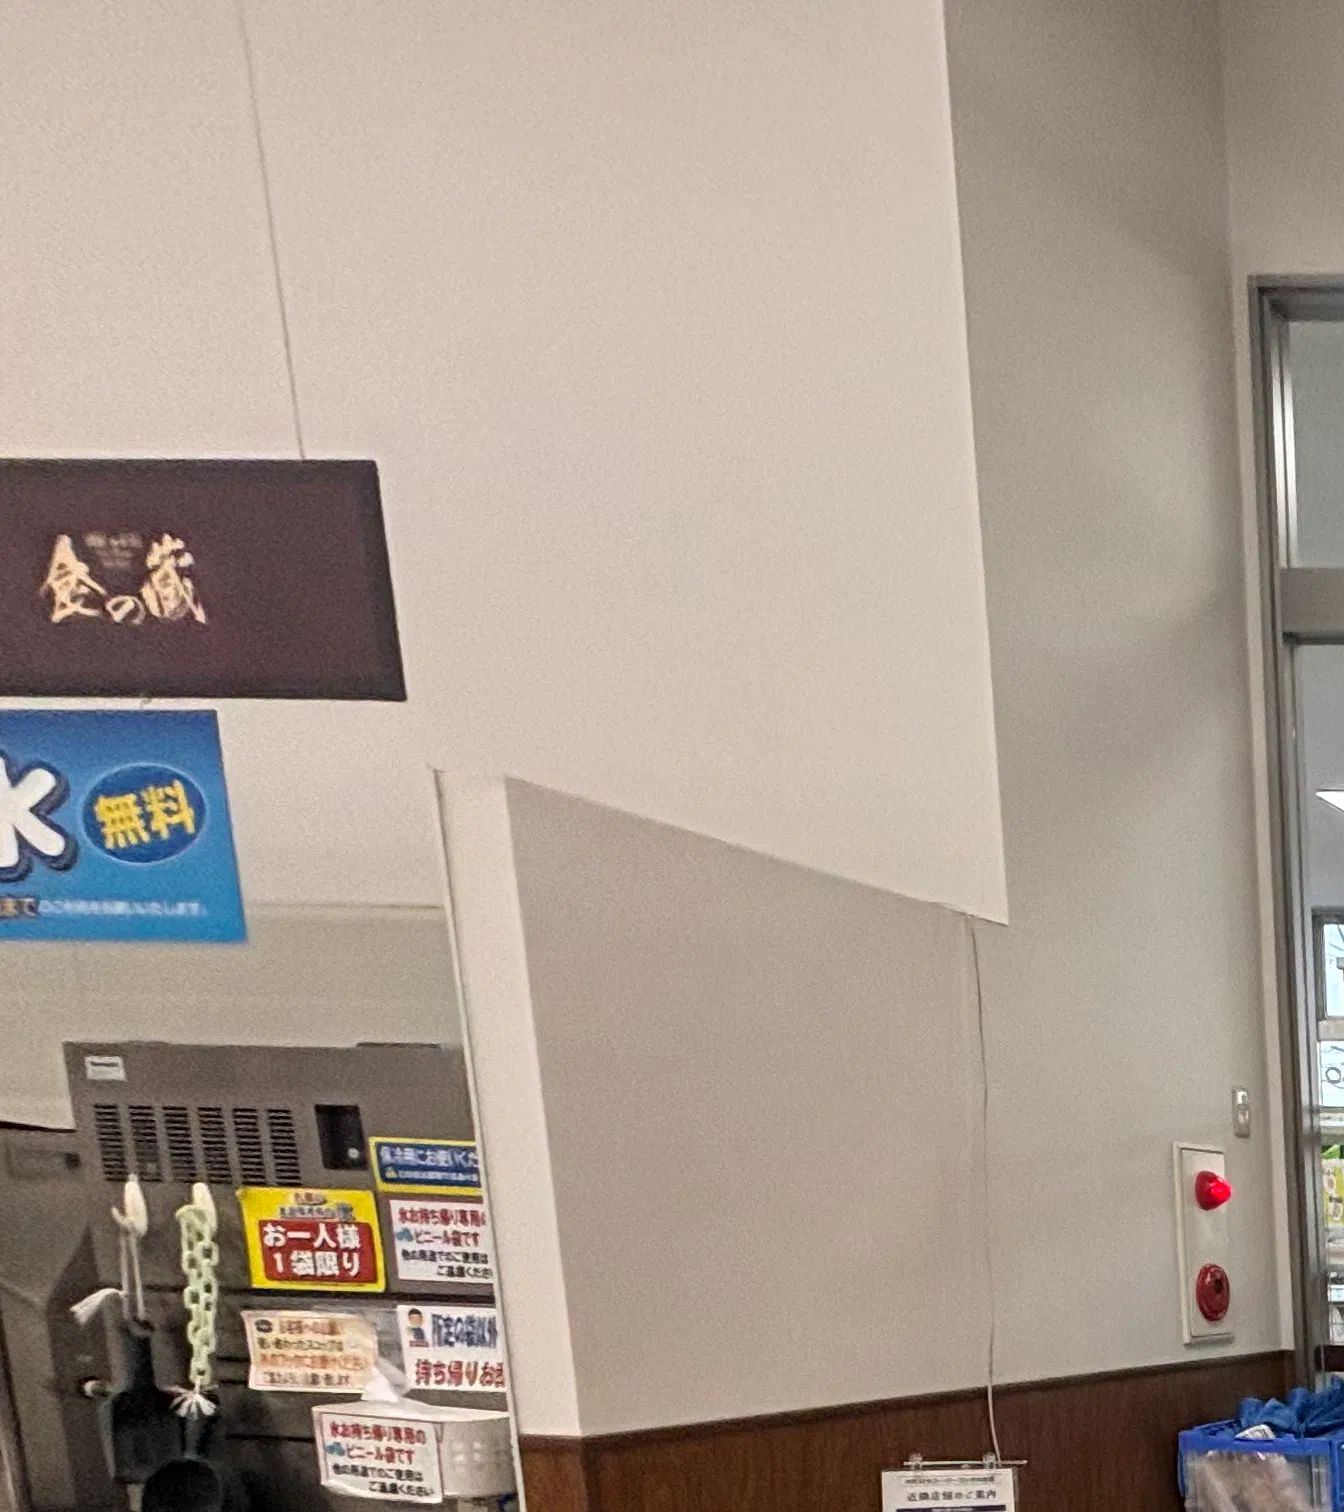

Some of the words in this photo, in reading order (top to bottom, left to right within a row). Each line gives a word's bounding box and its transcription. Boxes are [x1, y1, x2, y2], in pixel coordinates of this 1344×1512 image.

[39, 533, 207, 624] 食の蔵
[94, 780, 195, 849] 無料
[263, 1223, 361, 1249] お一人様
